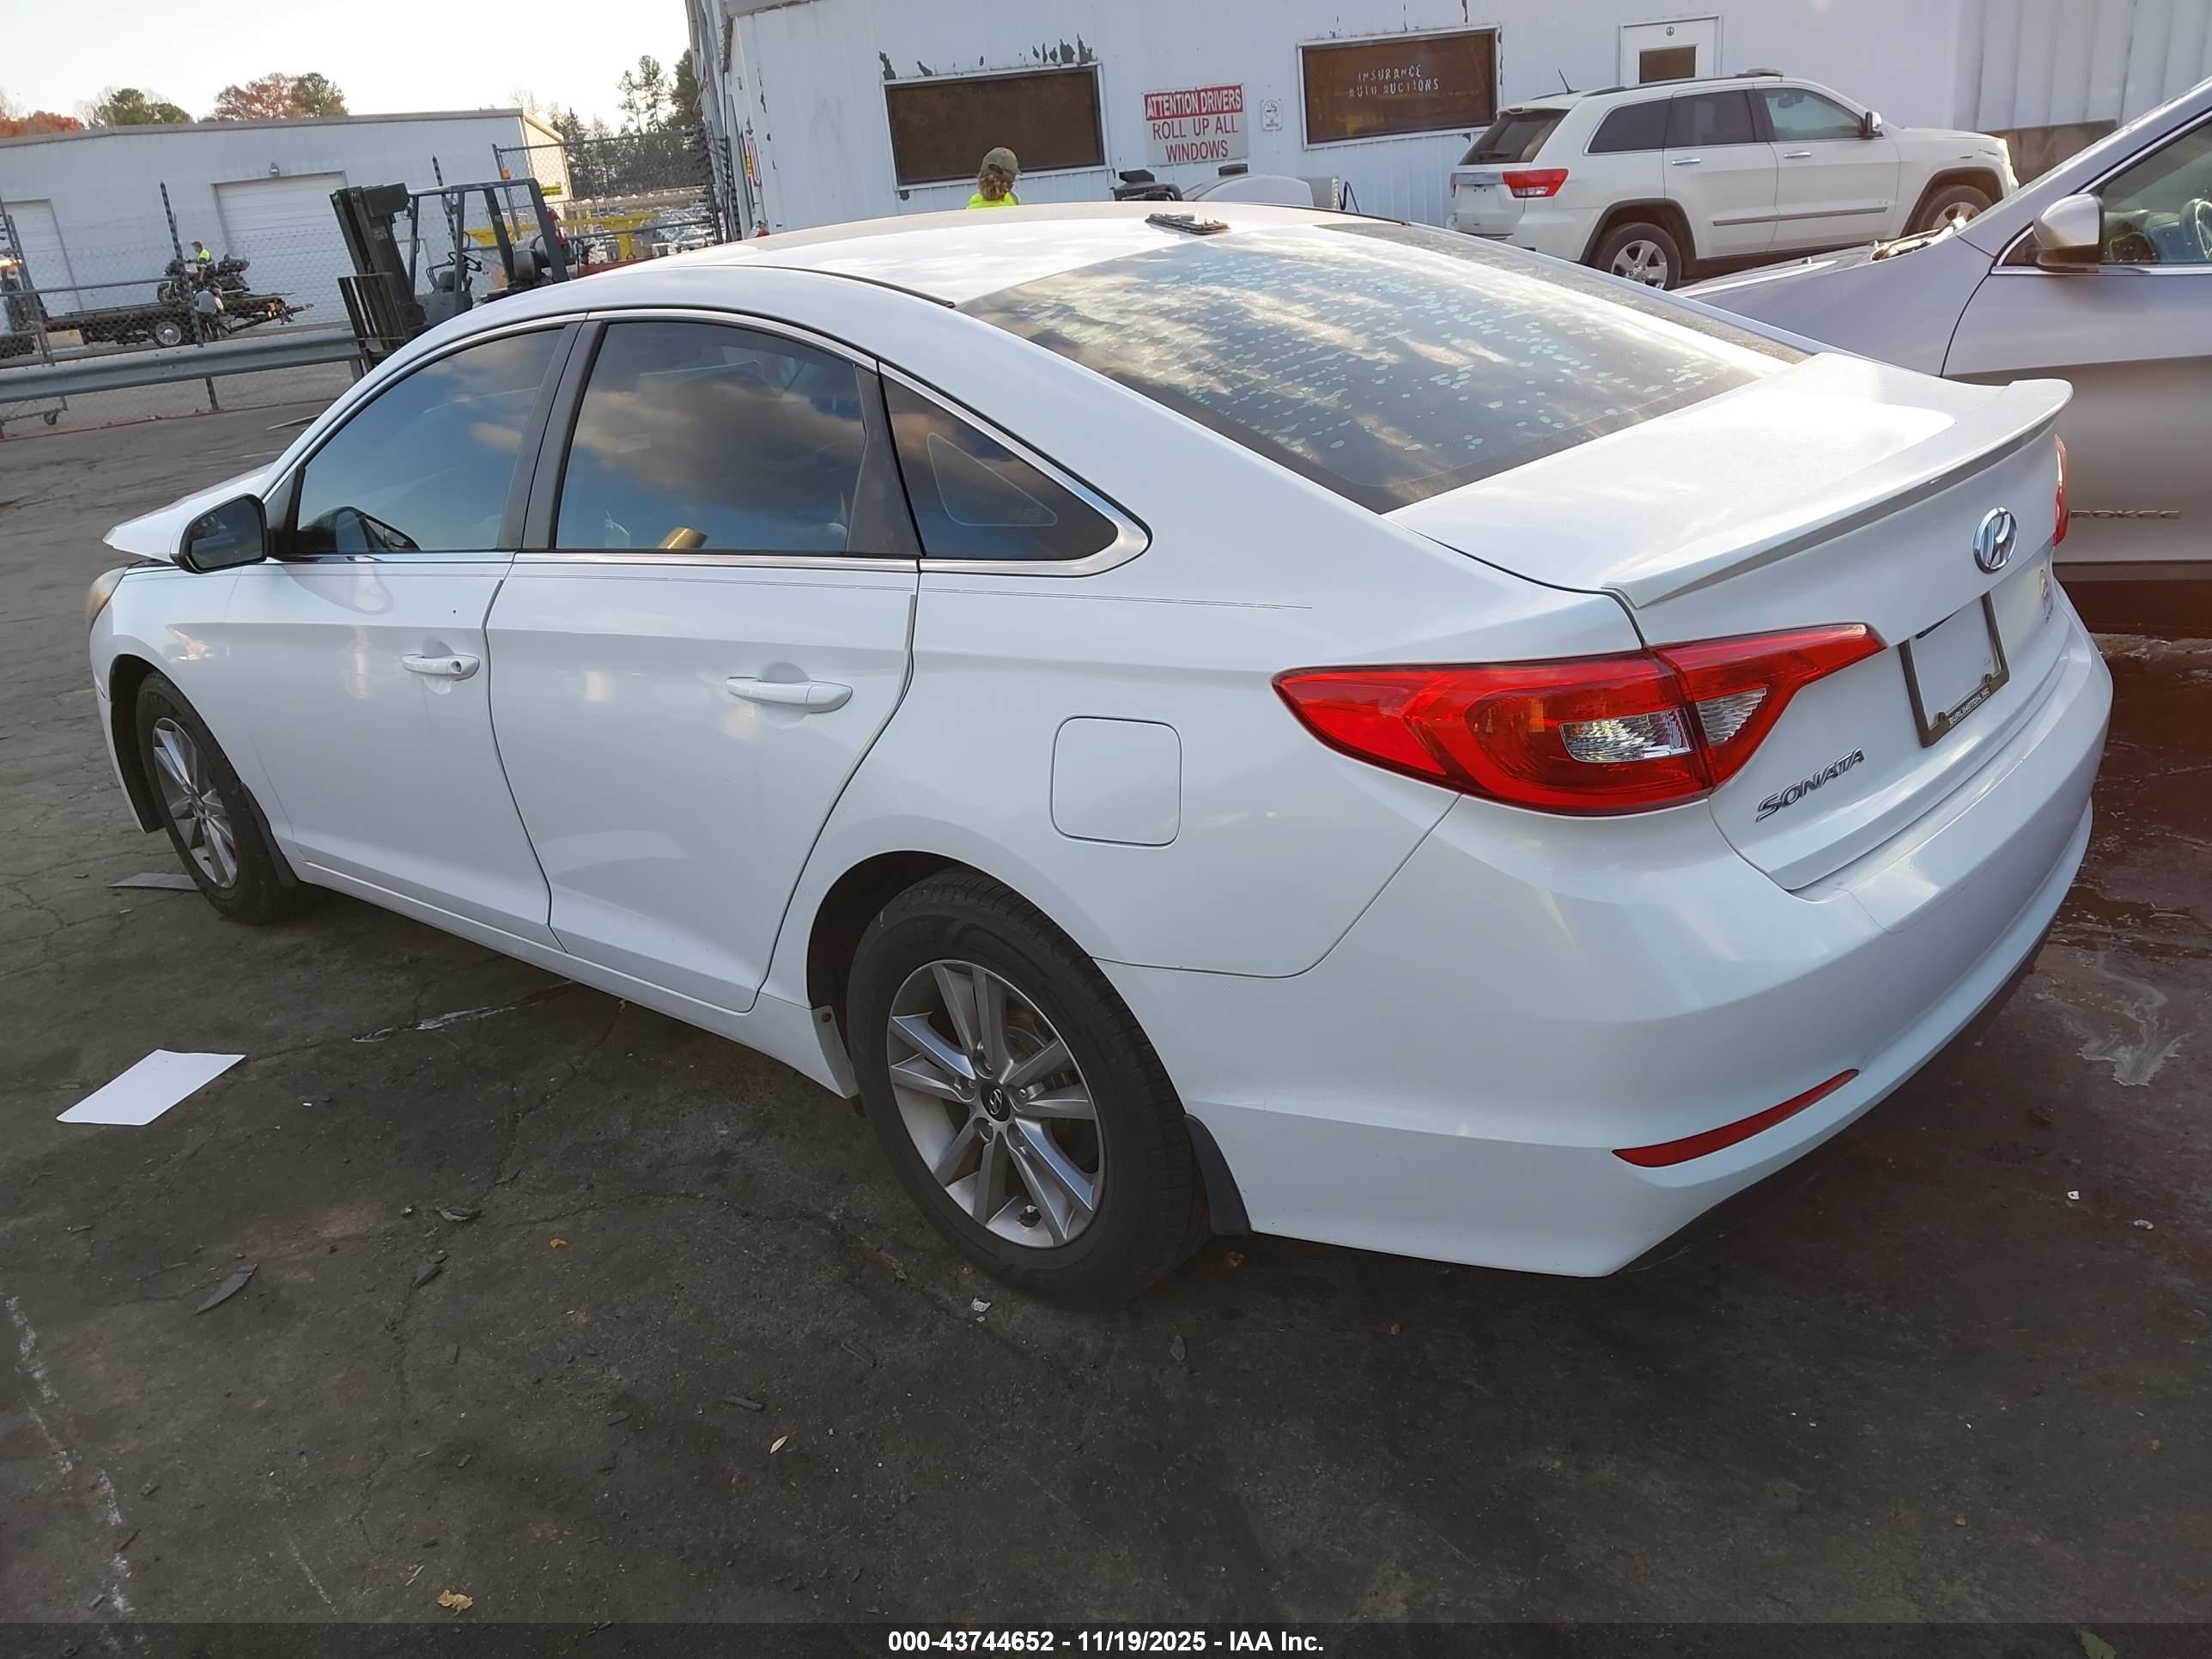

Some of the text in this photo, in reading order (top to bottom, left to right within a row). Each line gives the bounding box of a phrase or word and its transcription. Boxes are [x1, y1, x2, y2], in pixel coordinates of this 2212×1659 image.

[1146, 88, 1242, 118] ATTENTION DRIVERS
[1152, 115, 1238, 141] ROLL UP ALL
[1166, 140, 1229, 162] WINDOWS
[1755, 747, 1866, 823] SONATA
